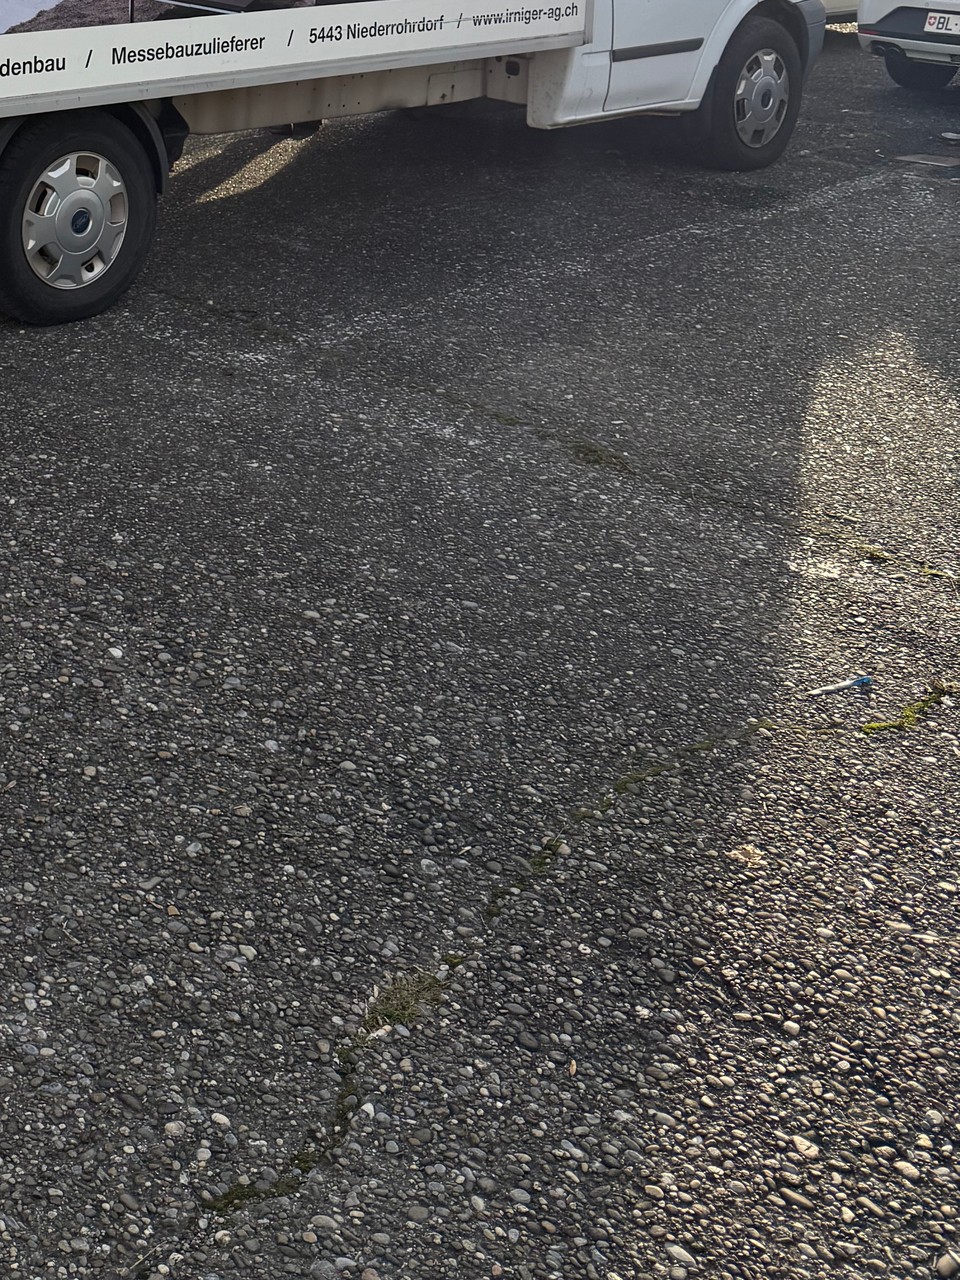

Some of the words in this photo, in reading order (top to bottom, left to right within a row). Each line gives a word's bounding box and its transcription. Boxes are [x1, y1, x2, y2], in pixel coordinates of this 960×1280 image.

[111, 36, 266, 65] Messebauzulieferer
[309, 25, 343, 44] 5443
[346, 15, 445, 40] Niederrohrdorf
[472, 2, 579, 27] www.irniger-ag.ch
